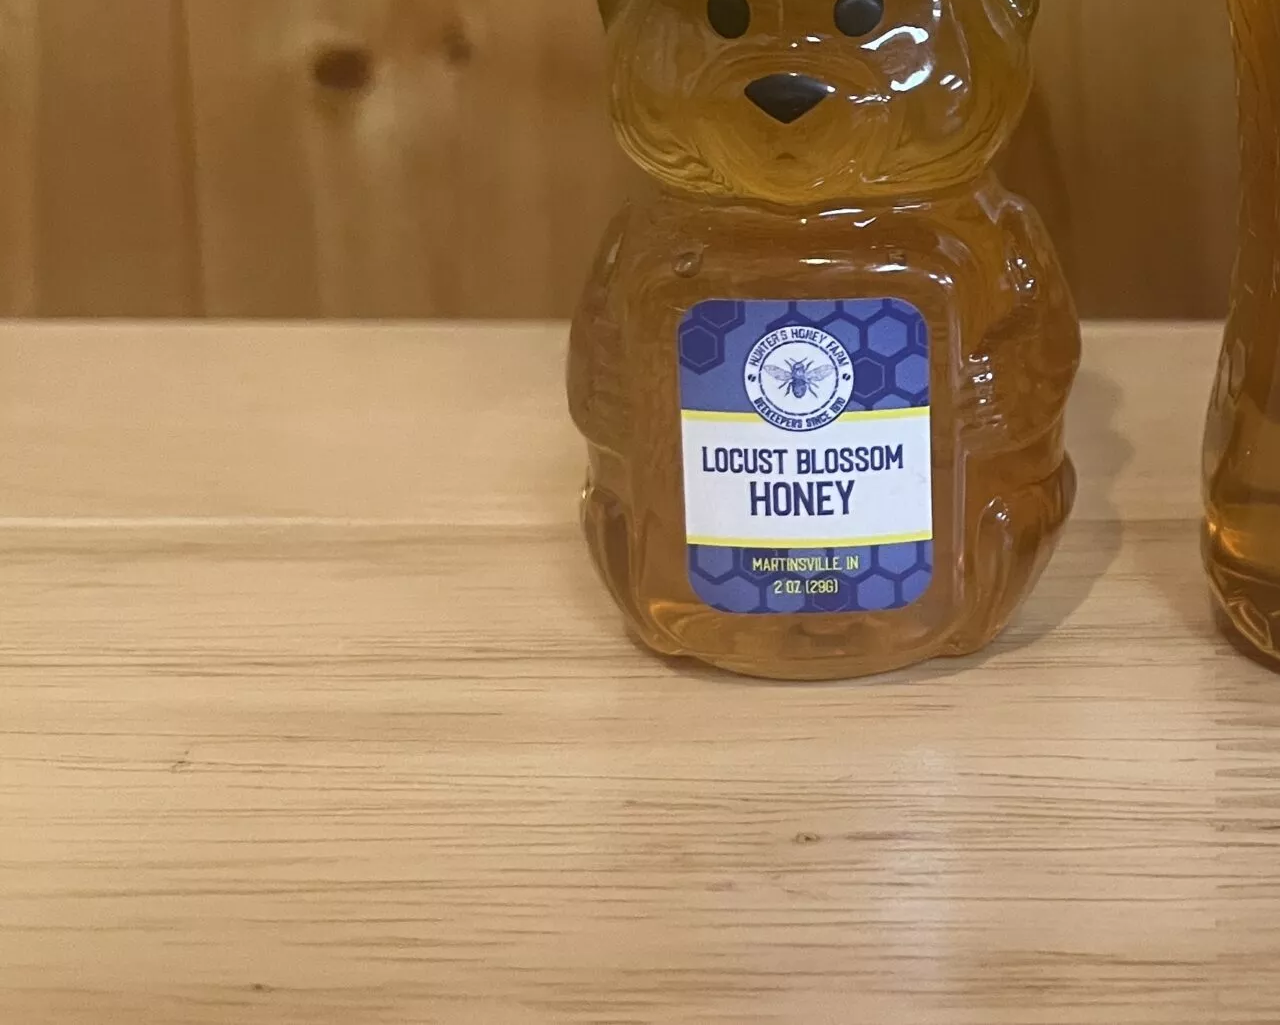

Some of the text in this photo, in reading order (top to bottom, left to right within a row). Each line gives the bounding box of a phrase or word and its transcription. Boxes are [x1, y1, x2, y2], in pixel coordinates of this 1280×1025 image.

[749, 327, 848, 368] HUNTER'S HONEY FARM
[753, 397, 803, 429] BEEKEEPERS
[806, 412, 832, 429] SINCE
[702, 444, 904, 474] LOCUST BLOSSOM
[749, 481, 855, 516] HONEY
[846, 556, 859, 569] IN
[774, 581, 838, 594] 2 OZ (29G)
